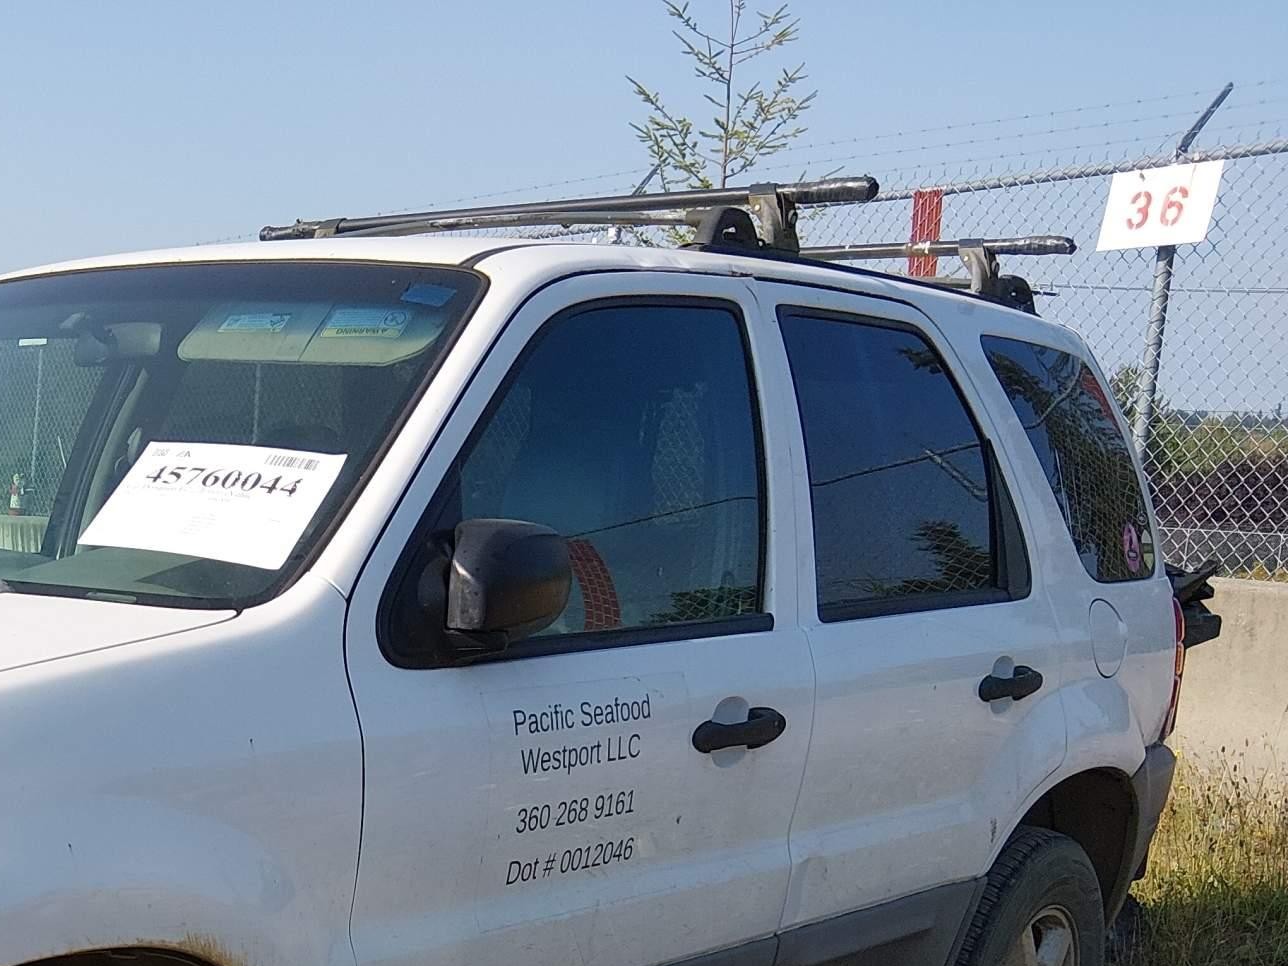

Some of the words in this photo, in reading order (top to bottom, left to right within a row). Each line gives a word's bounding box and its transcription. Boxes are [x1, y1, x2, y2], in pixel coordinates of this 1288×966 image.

[1126, 186, 1189, 230] 36
[145, 465, 304, 497] 45760044
[513, 703, 575, 736] Pacific
[580, 693, 651, 727] Seafood
[520, 740, 602, 775] Westport
[607, 733, 641, 762] LLC
[515, 804, 551, 834] 360
[555, 797, 589, 827] 268
[594, 789, 635, 820] 9161
[505, 857, 539, 886] Dot
[542, 852, 556, 878] #
[559, 837, 635, 874] 0012046
